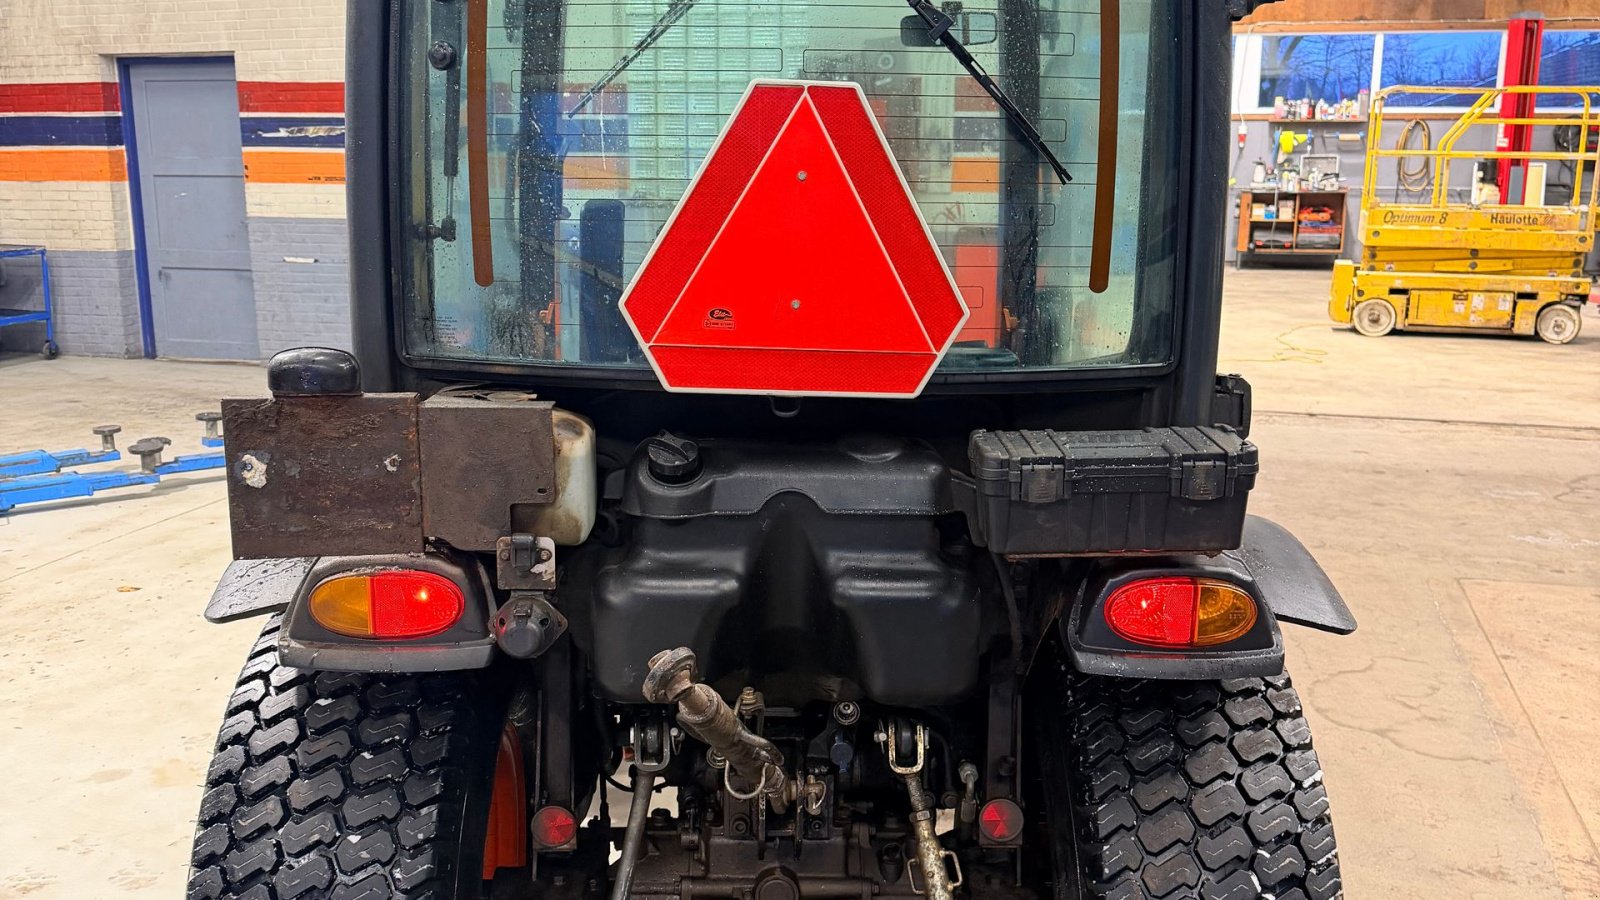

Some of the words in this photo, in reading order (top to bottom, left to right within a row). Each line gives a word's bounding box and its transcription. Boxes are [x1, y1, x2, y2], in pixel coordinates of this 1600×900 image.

[1383, 210, 1435, 225] Optimum
[1439, 211, 1449, 224] 8
[1490, 212, 1538, 226] Haulotte
